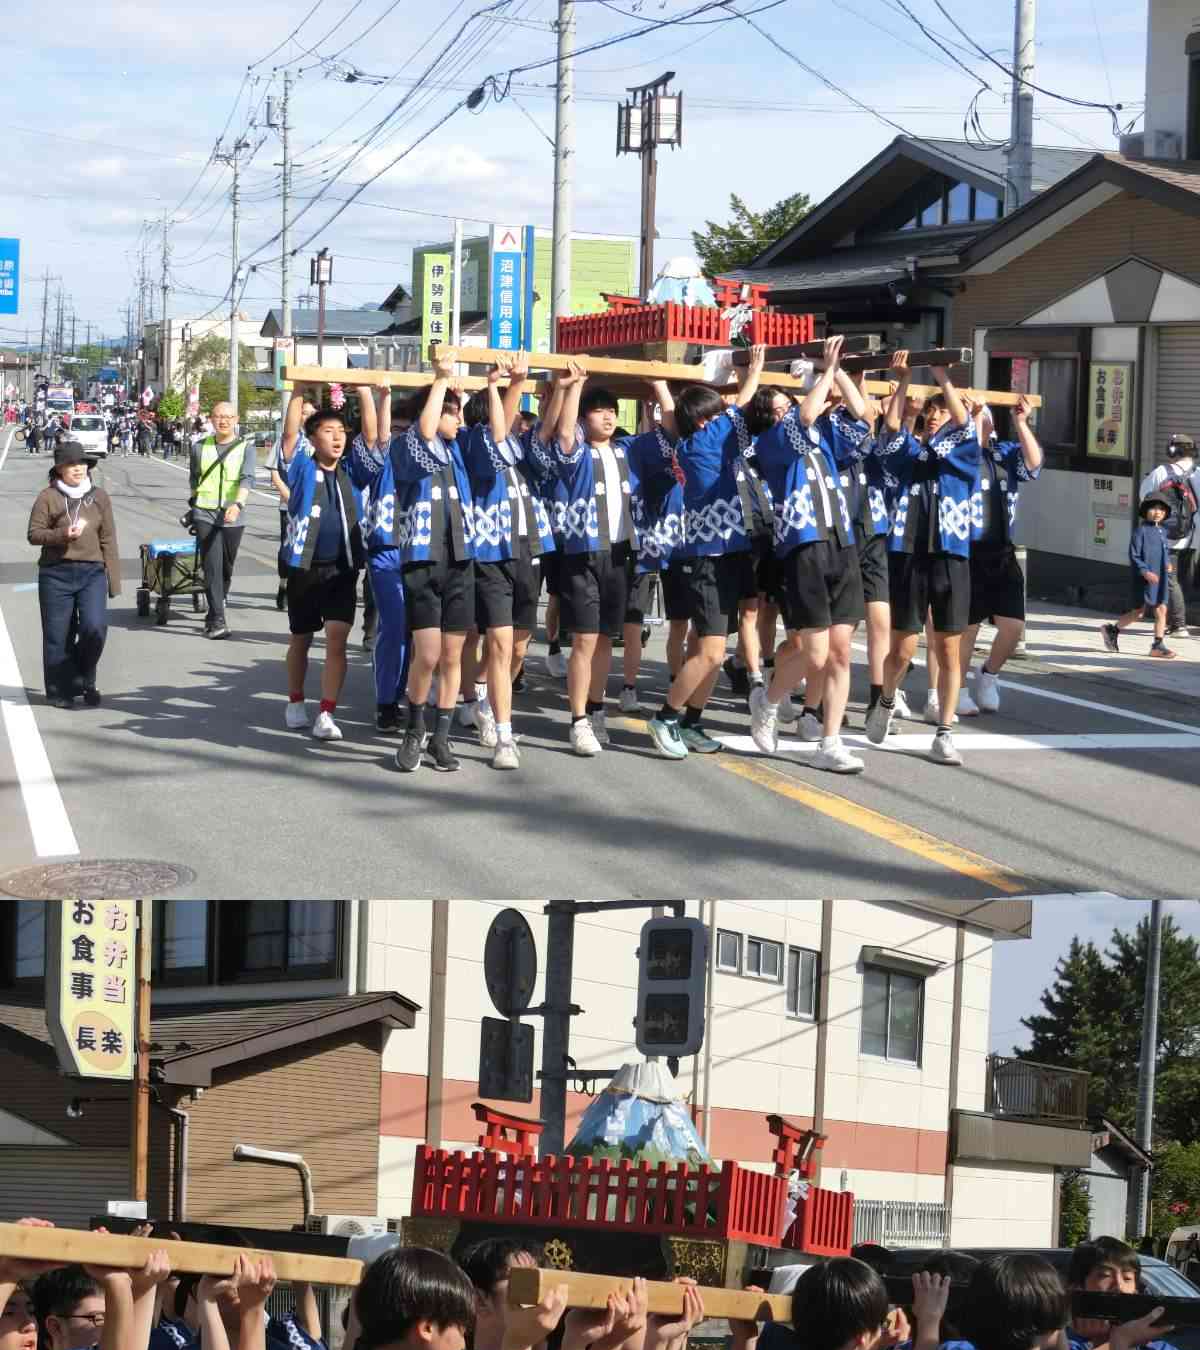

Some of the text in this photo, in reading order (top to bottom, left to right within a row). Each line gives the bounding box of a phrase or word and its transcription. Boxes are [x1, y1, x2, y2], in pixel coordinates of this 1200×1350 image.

[499, 258, 514, 350] 沼津信用金庫
[71, 900, 95, 1000] お食事
[104, 904, 128, 1004] お弁当
[76, 1026, 122, 1055] 長楽
